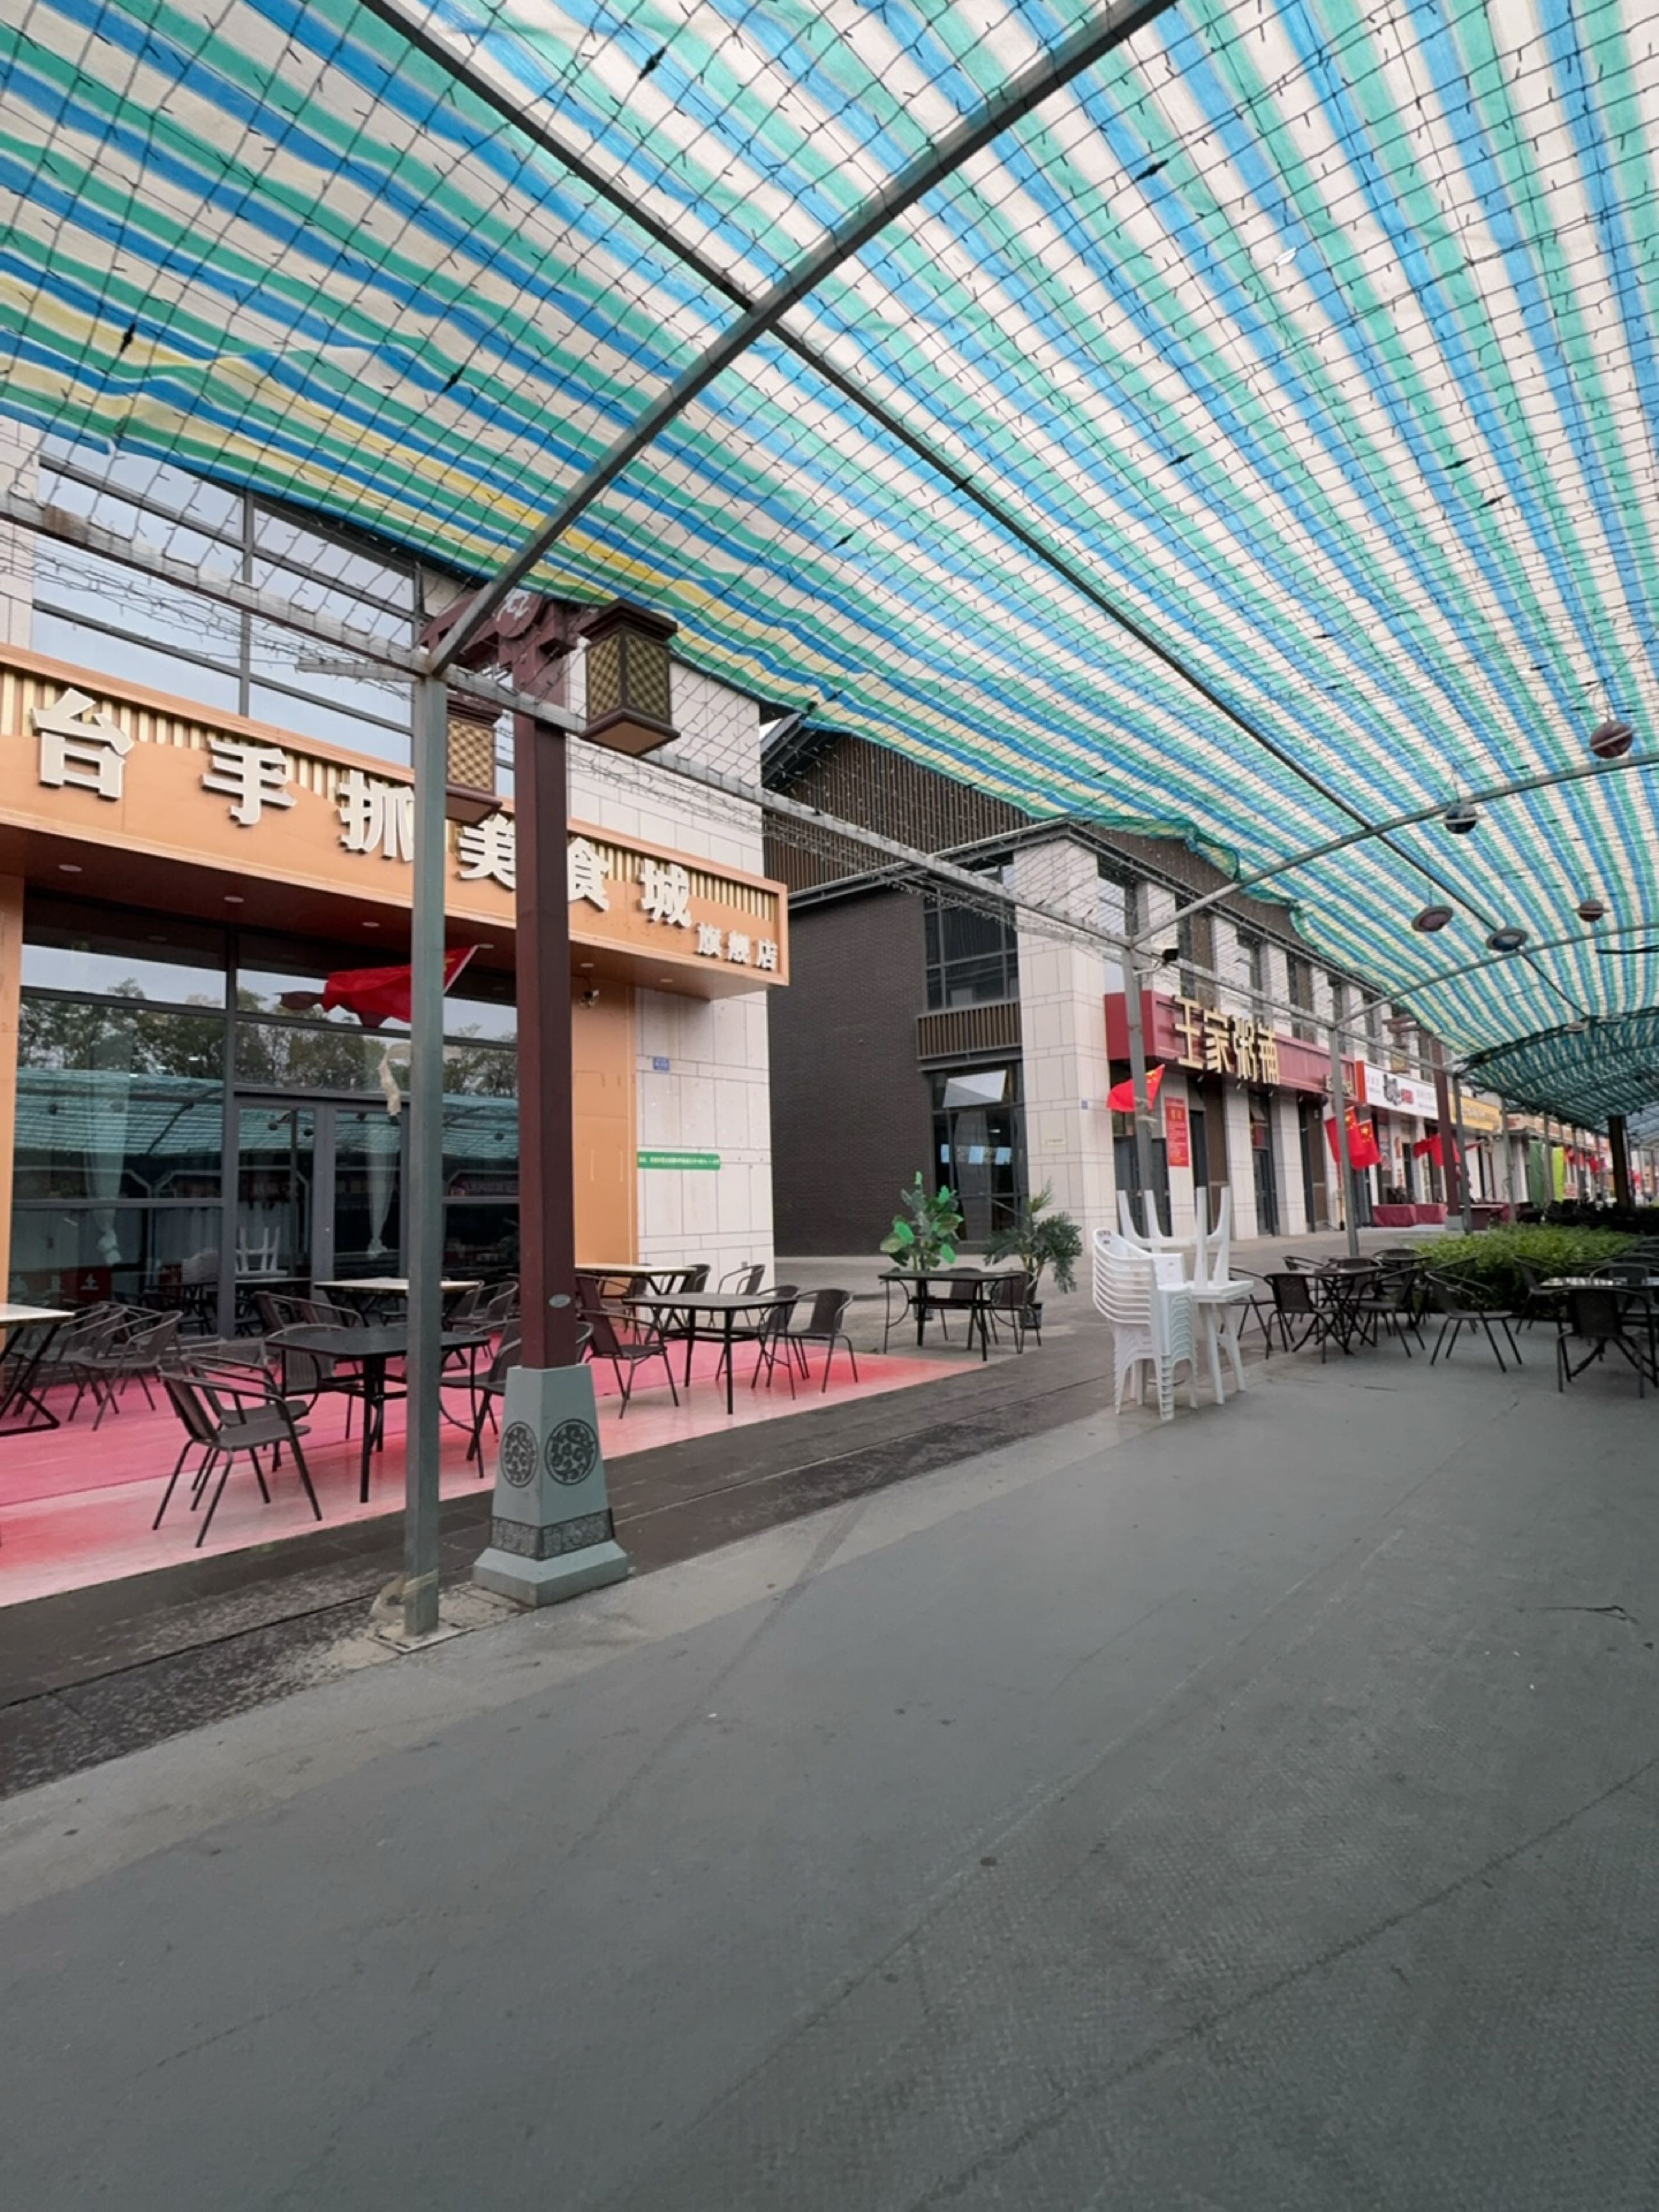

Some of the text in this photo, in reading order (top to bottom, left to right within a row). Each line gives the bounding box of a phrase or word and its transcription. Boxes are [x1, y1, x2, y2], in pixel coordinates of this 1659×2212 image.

[32, 687, 692, 928] 台手抓美食城
[697, 922, 778, 971] 旗舰店
[1174, 995, 1280, 1085] 王家粥铺
